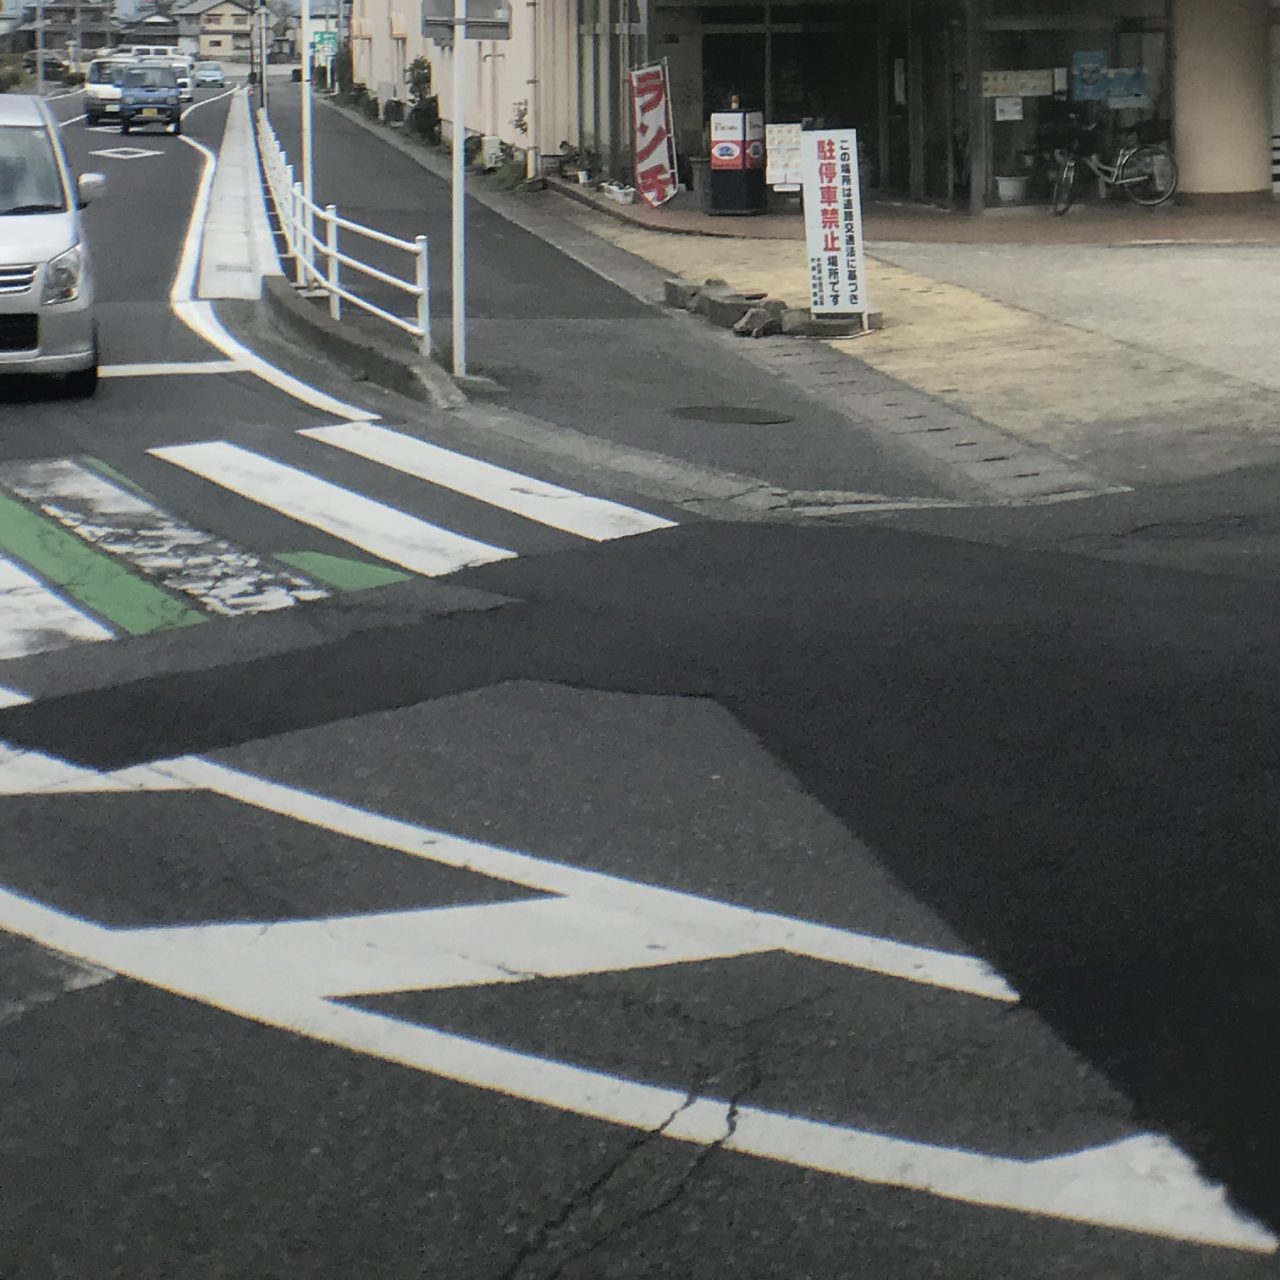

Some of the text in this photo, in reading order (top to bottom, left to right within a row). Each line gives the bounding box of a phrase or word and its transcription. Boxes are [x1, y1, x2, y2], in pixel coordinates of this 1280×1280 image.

[636, 72, 672, 202] ランチ
[816, 138, 841, 253] 駐停車禁止
